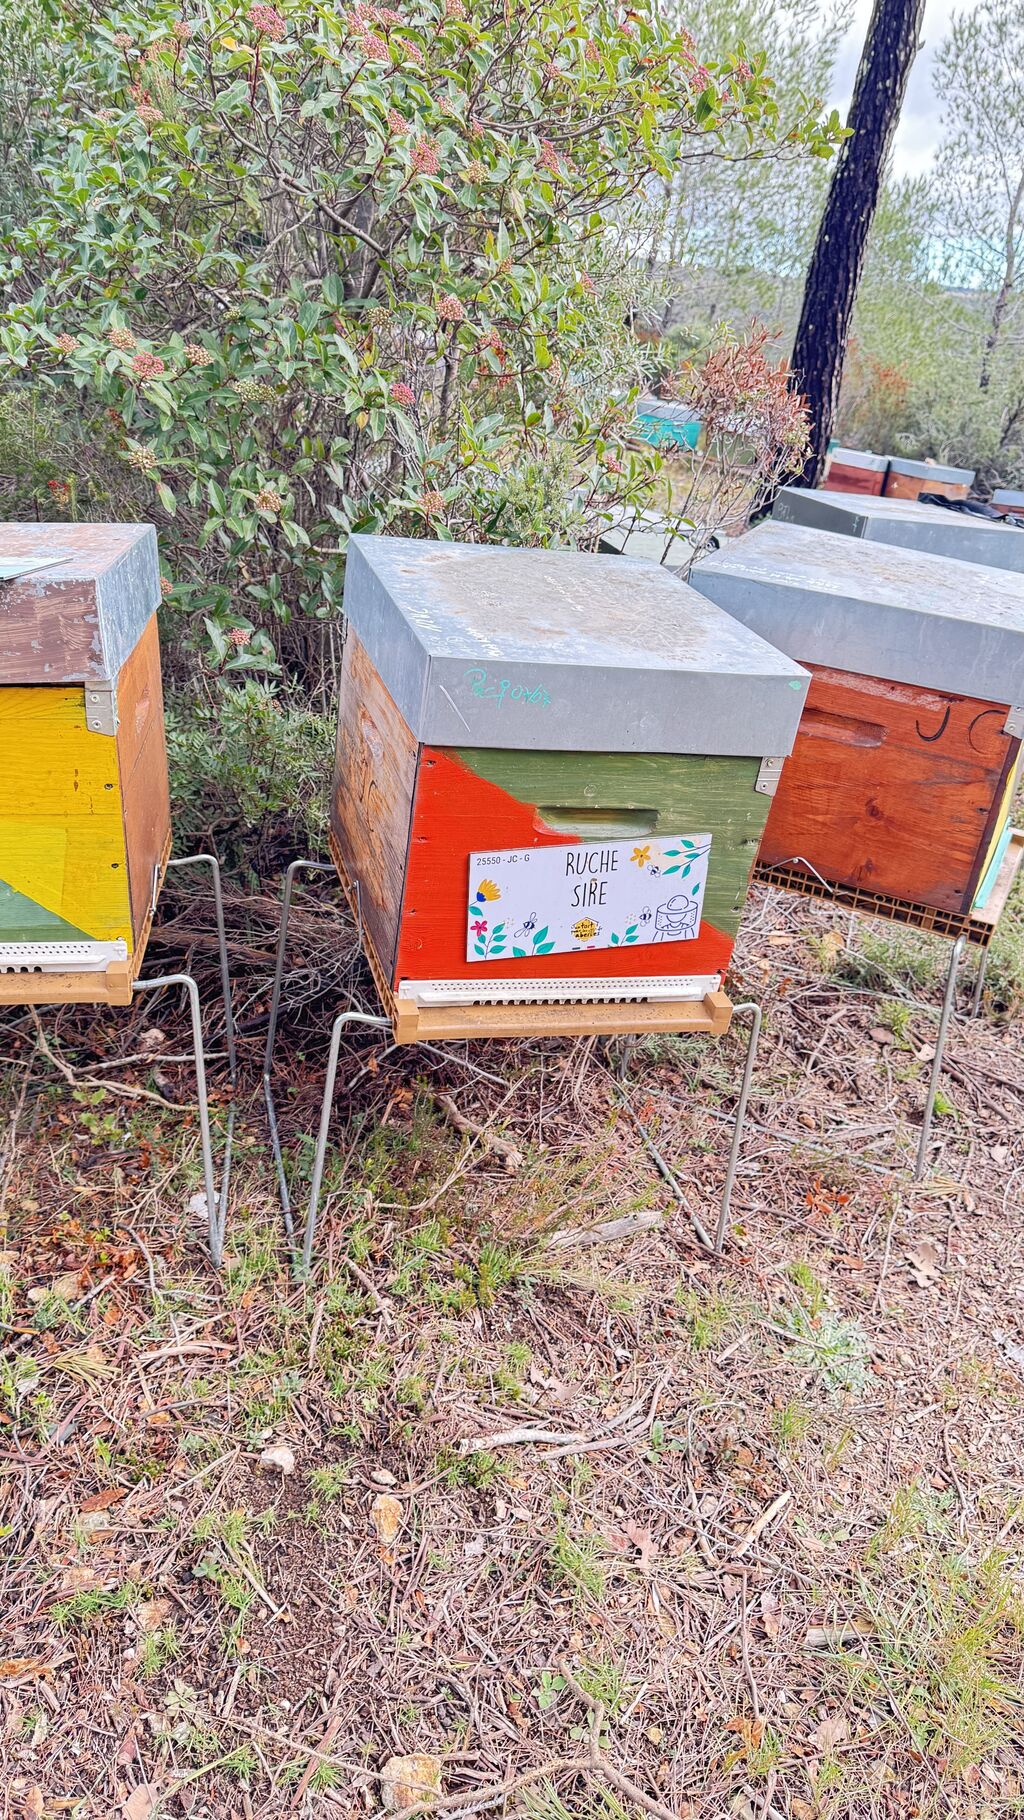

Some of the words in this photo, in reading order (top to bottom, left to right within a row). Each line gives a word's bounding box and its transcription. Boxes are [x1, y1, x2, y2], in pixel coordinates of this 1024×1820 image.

[476, 856, 501, 867] 25550
[507, 854, 518, 864] JC
[565, 849, 619, 877] RUCHE
[571, 877, 608, 908] SIRE
